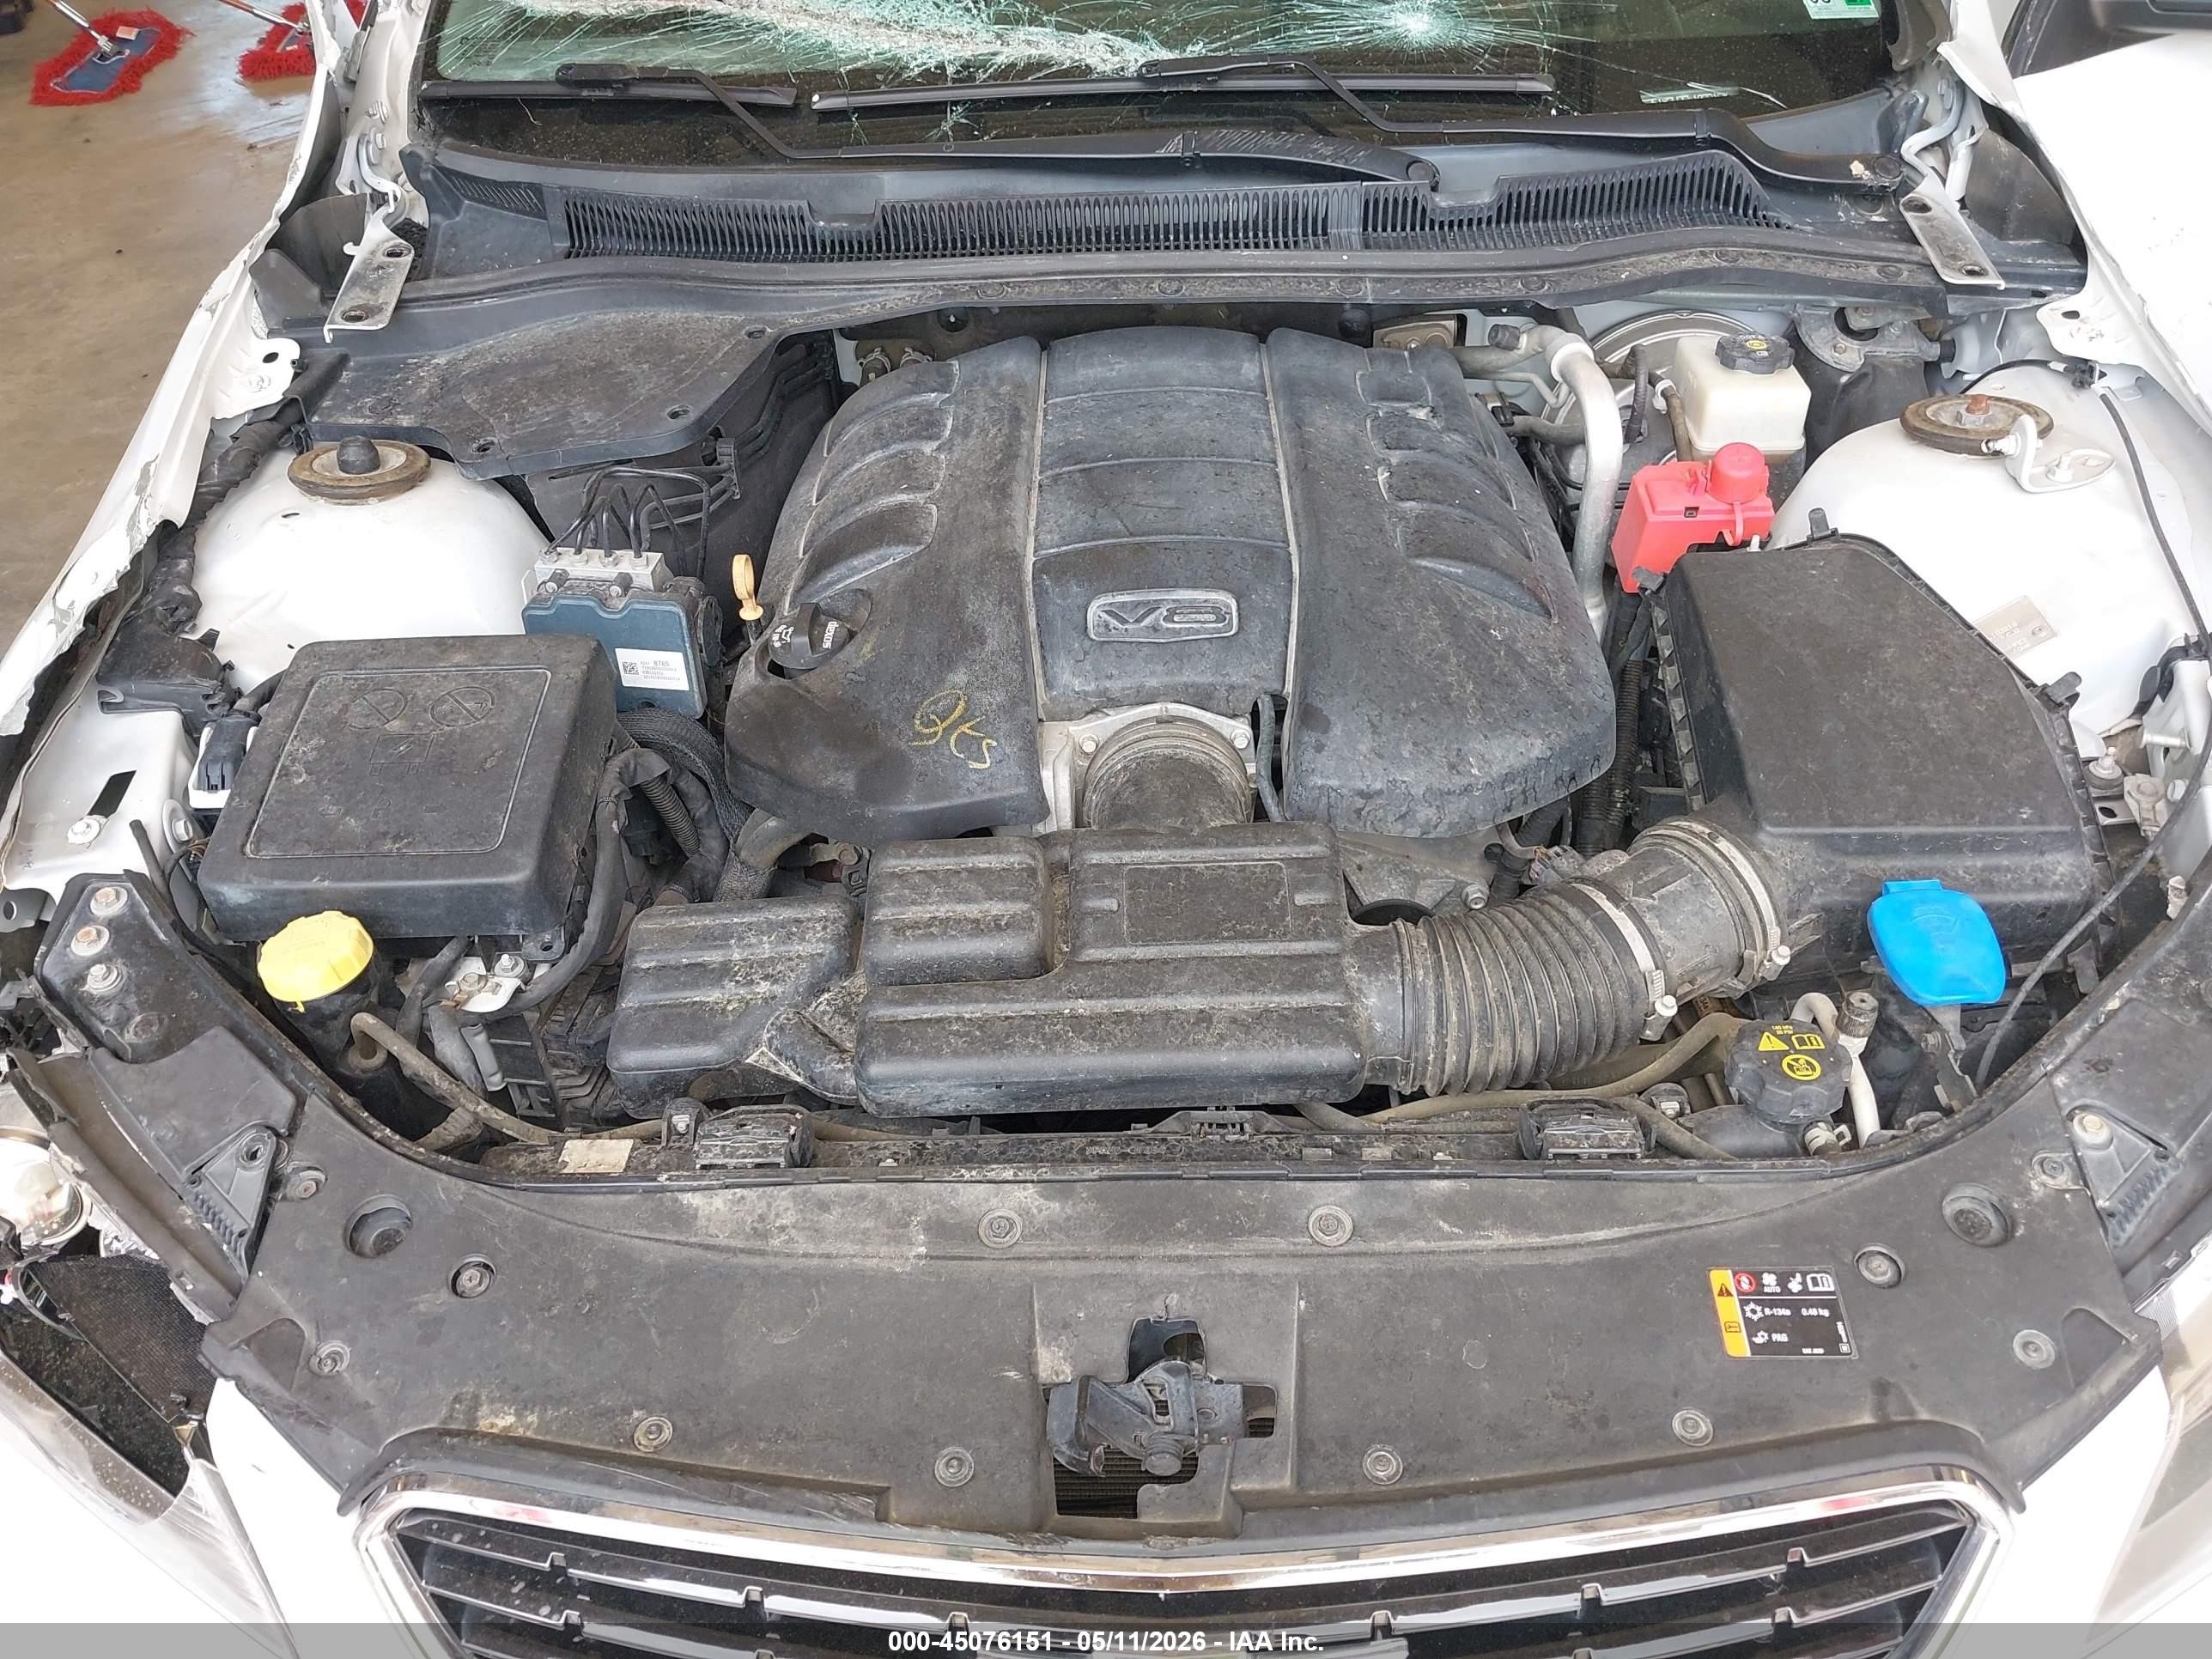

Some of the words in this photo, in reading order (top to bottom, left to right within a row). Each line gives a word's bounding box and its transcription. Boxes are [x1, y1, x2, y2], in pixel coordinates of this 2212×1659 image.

[822, 621, 839, 650] dexos
[1819, 1308, 1830, 1317] kg
[1771, 1334, 1789, 1342] PAG
